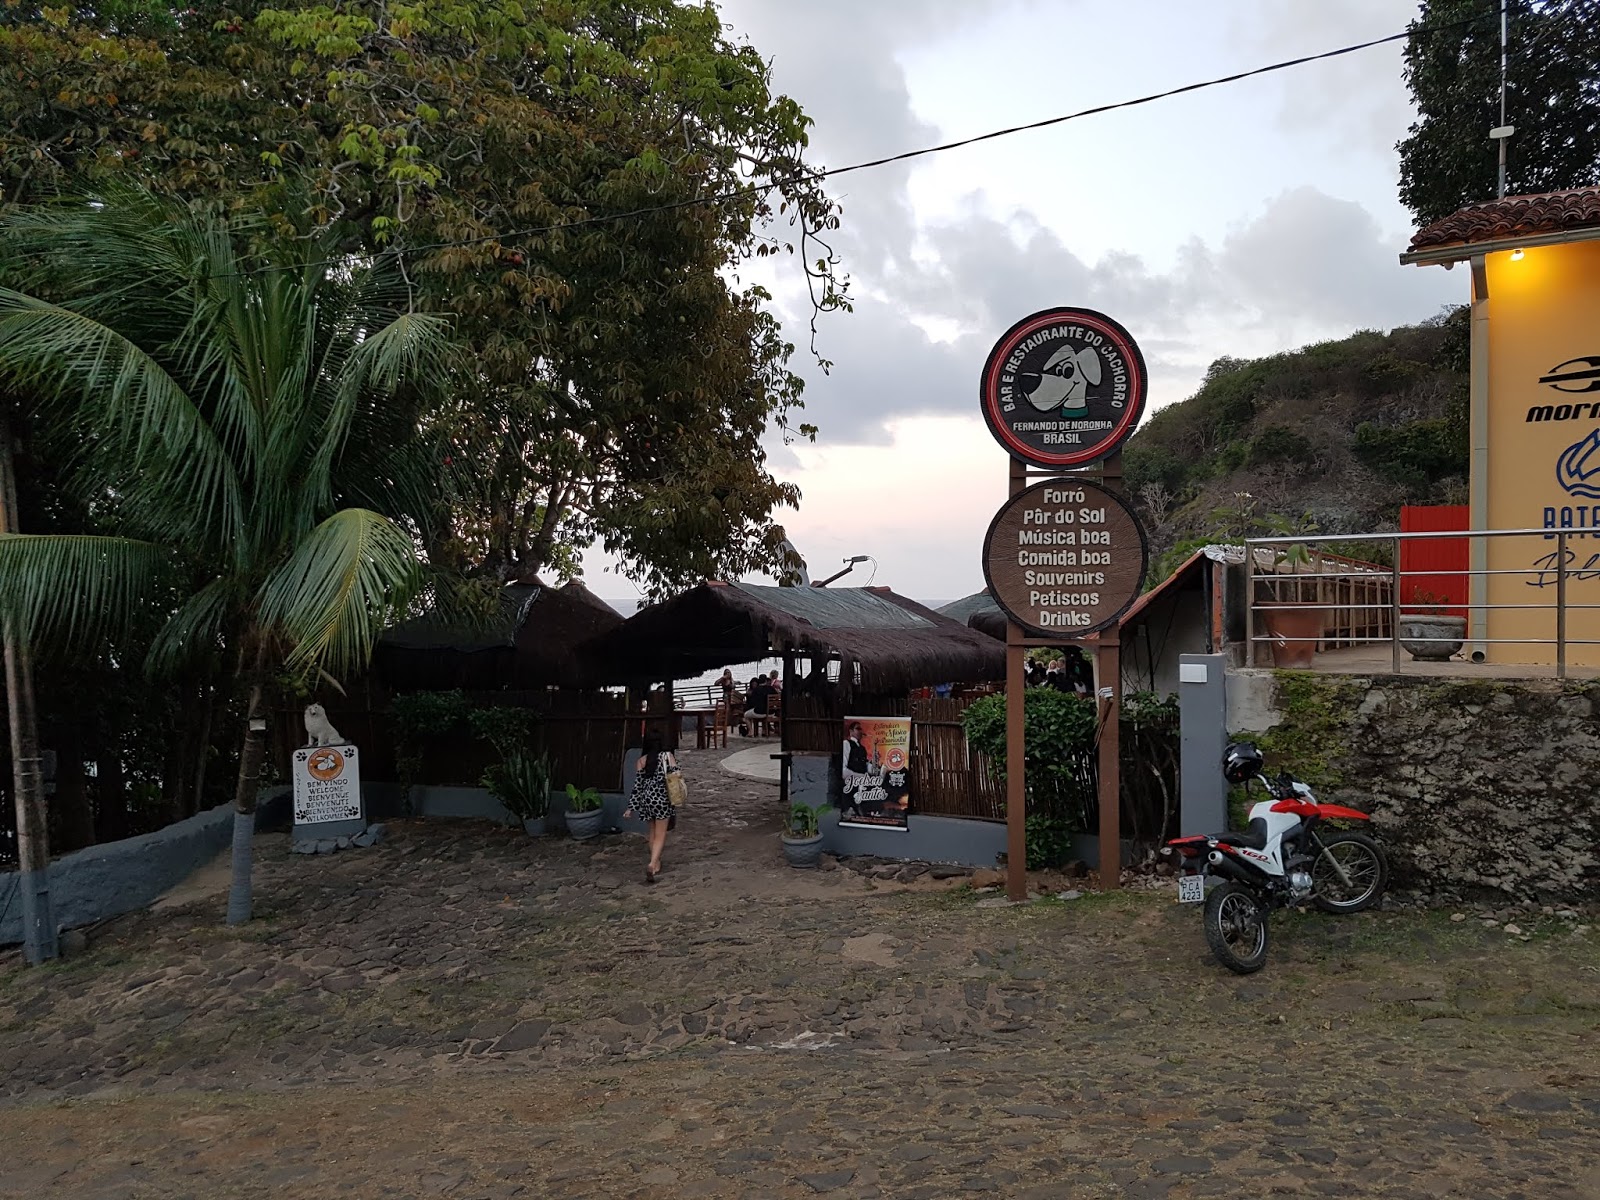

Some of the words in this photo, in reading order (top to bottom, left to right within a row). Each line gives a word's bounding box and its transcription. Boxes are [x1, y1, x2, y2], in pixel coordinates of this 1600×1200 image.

[1084, 330, 1103, 347] DO
[1005, 326, 1084, 373] RESTAURANTE
[1002, 374, 1014, 383] E
[1101, 344, 1127, 408] CACHORRO
[1001, 386, 1016, 412] BAR
[1013, 421, 1058, 431] FERNANDO
[1058, 421, 1071, 430] DE
[1071, 420, 1113, 430] NORONHA
[1043, 433, 1082, 444] BRASIL
[1043, 487, 1085, 504] Forró
[1023, 508, 1051, 525] Pôr
[1055, 509, 1075, 524] do
[1079, 507, 1105, 524] Sol
[1018, 529, 1076, 546] Música
[1080, 529, 1111, 545] boa
[1018, 550, 1076, 566] Comida
[1081, 549, 1111, 565] boa
[1024, 570, 1105, 586] Souvenirs
[1030, 590, 1100, 607] Petiscos
[1039, 610, 1091, 626] Drinks
[308, 792, 349, 801] BIENVENUE
[309, 786, 344, 795] WELCOME
[1182, 882, 1201, 892] PCA
[1181, 891, 1201, 900] 4223
